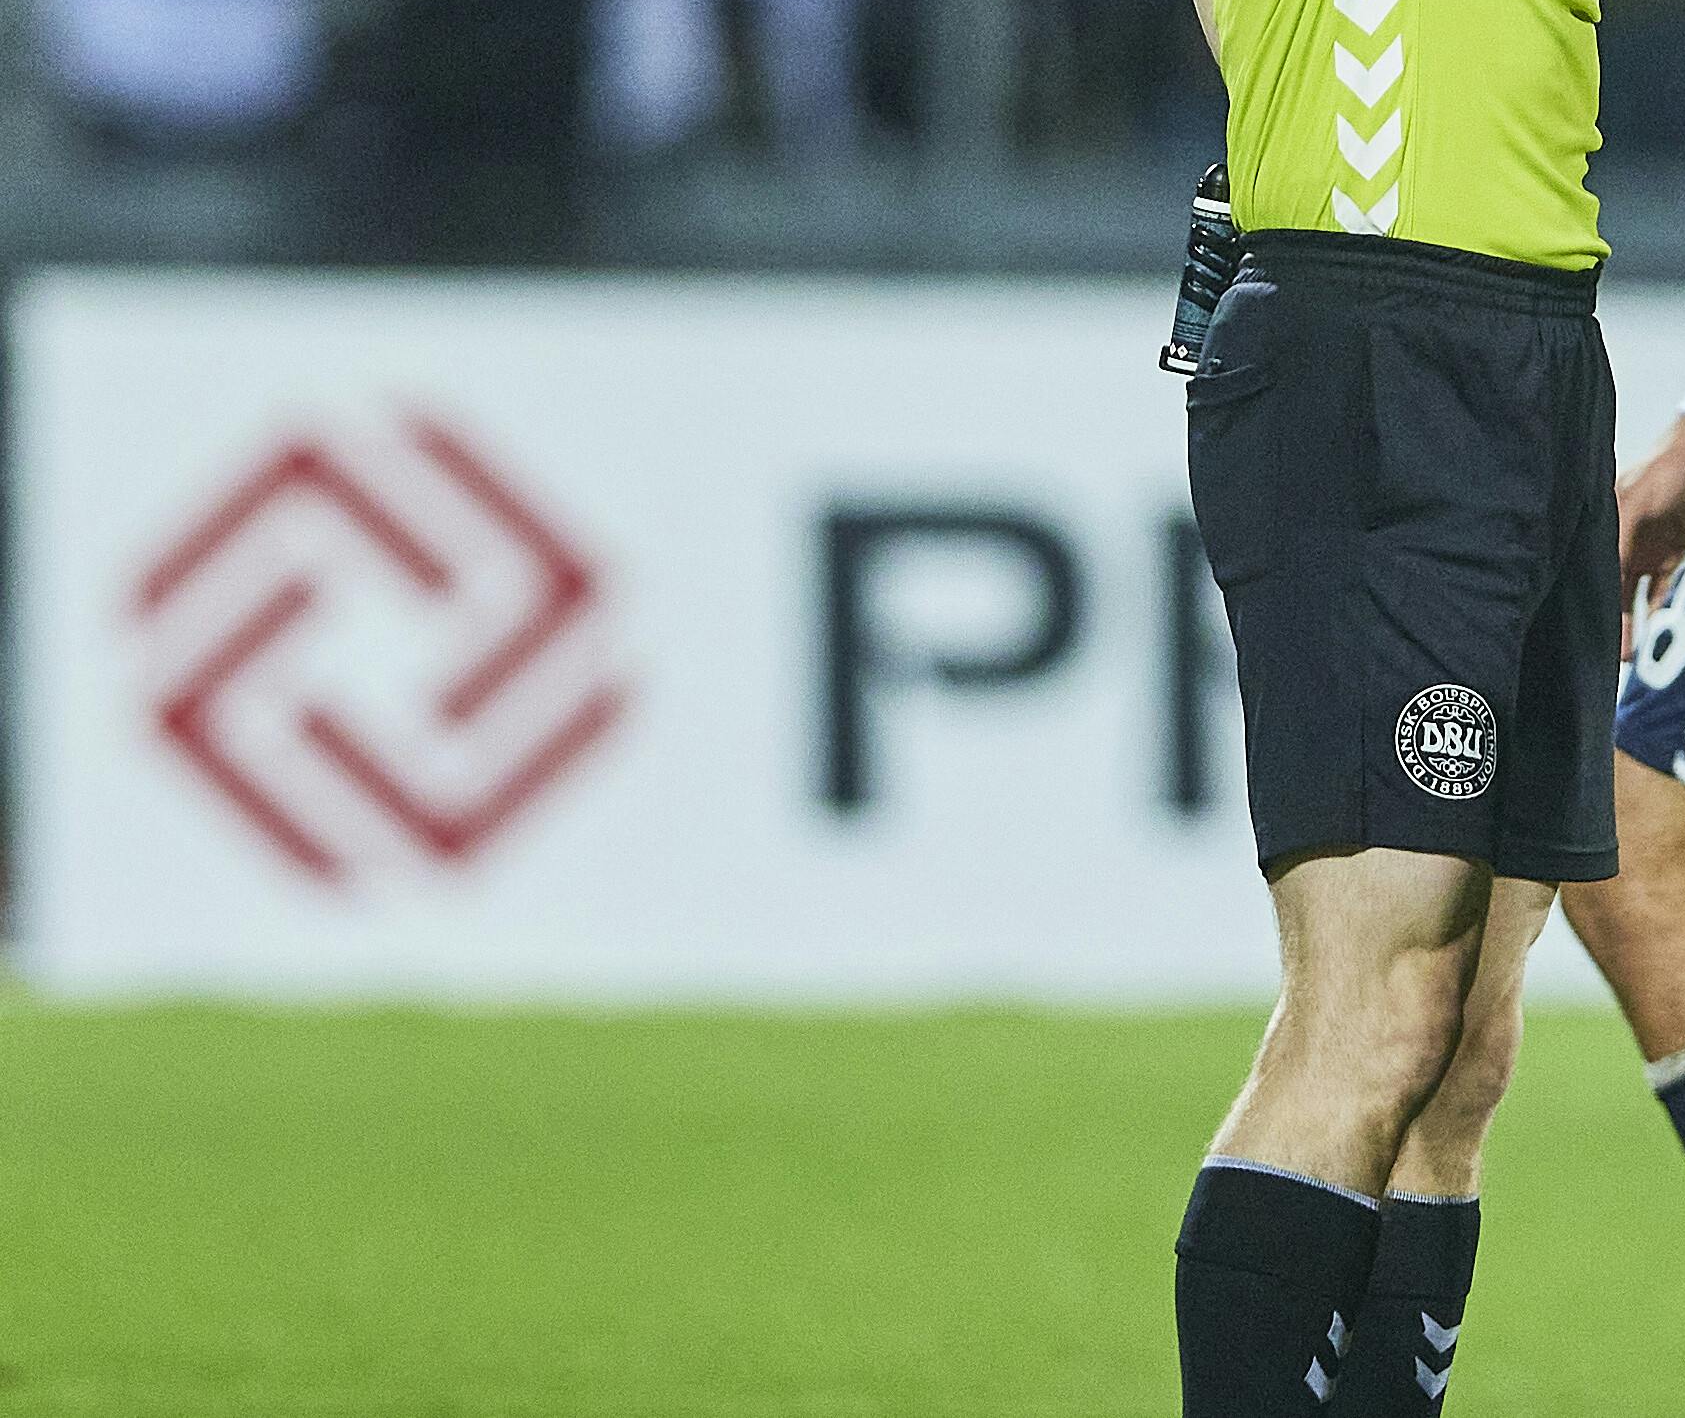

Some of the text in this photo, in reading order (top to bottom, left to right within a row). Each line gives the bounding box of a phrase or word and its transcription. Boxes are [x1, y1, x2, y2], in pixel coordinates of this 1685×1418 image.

[1400, 711, 1427, 780] DANSK
[1430, 777, 1474, 795] 1889
[1420, 721, 1482, 760] DBU
